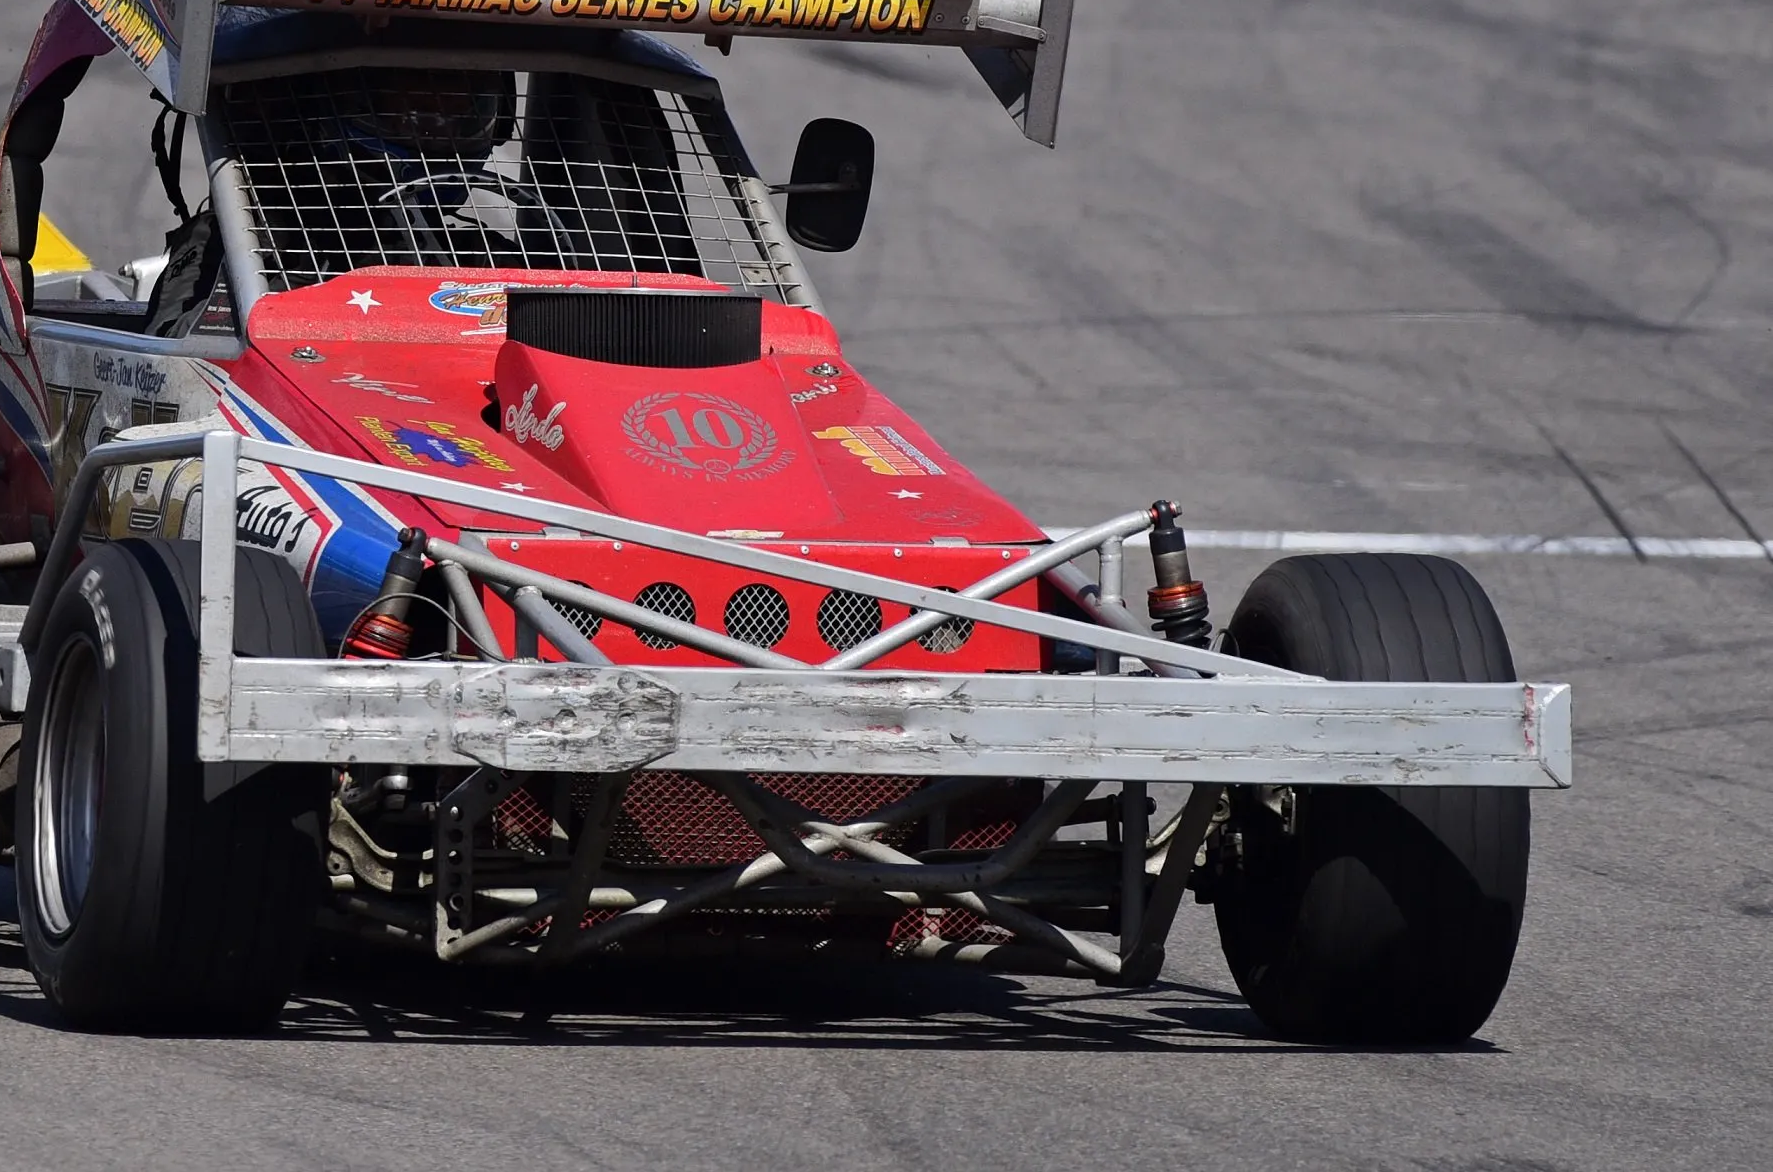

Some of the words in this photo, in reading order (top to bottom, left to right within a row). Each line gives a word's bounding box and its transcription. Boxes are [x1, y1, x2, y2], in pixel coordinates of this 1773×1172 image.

[505, 384, 566, 450] Linda
[650, 408, 744, 449] 10
[736, 450, 796, 482] MEMORY
